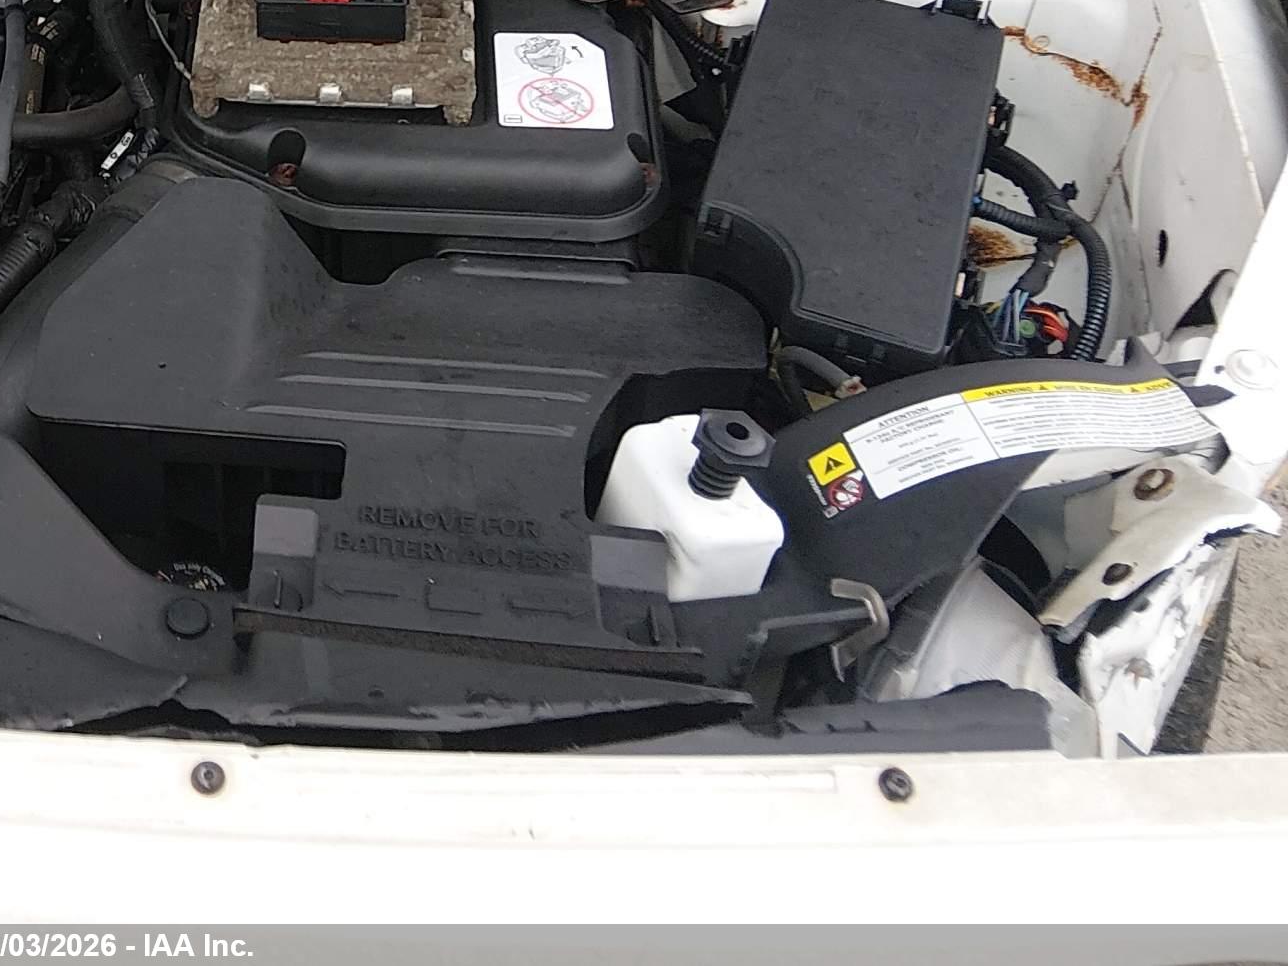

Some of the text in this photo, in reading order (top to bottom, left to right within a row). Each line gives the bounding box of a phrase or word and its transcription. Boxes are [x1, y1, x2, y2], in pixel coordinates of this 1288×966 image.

[878, 406, 929, 428] ATTENTION
[359, 505, 539, 538] REMOVE FOR
[334, 532, 572, 571] BATTERY ACCESS
